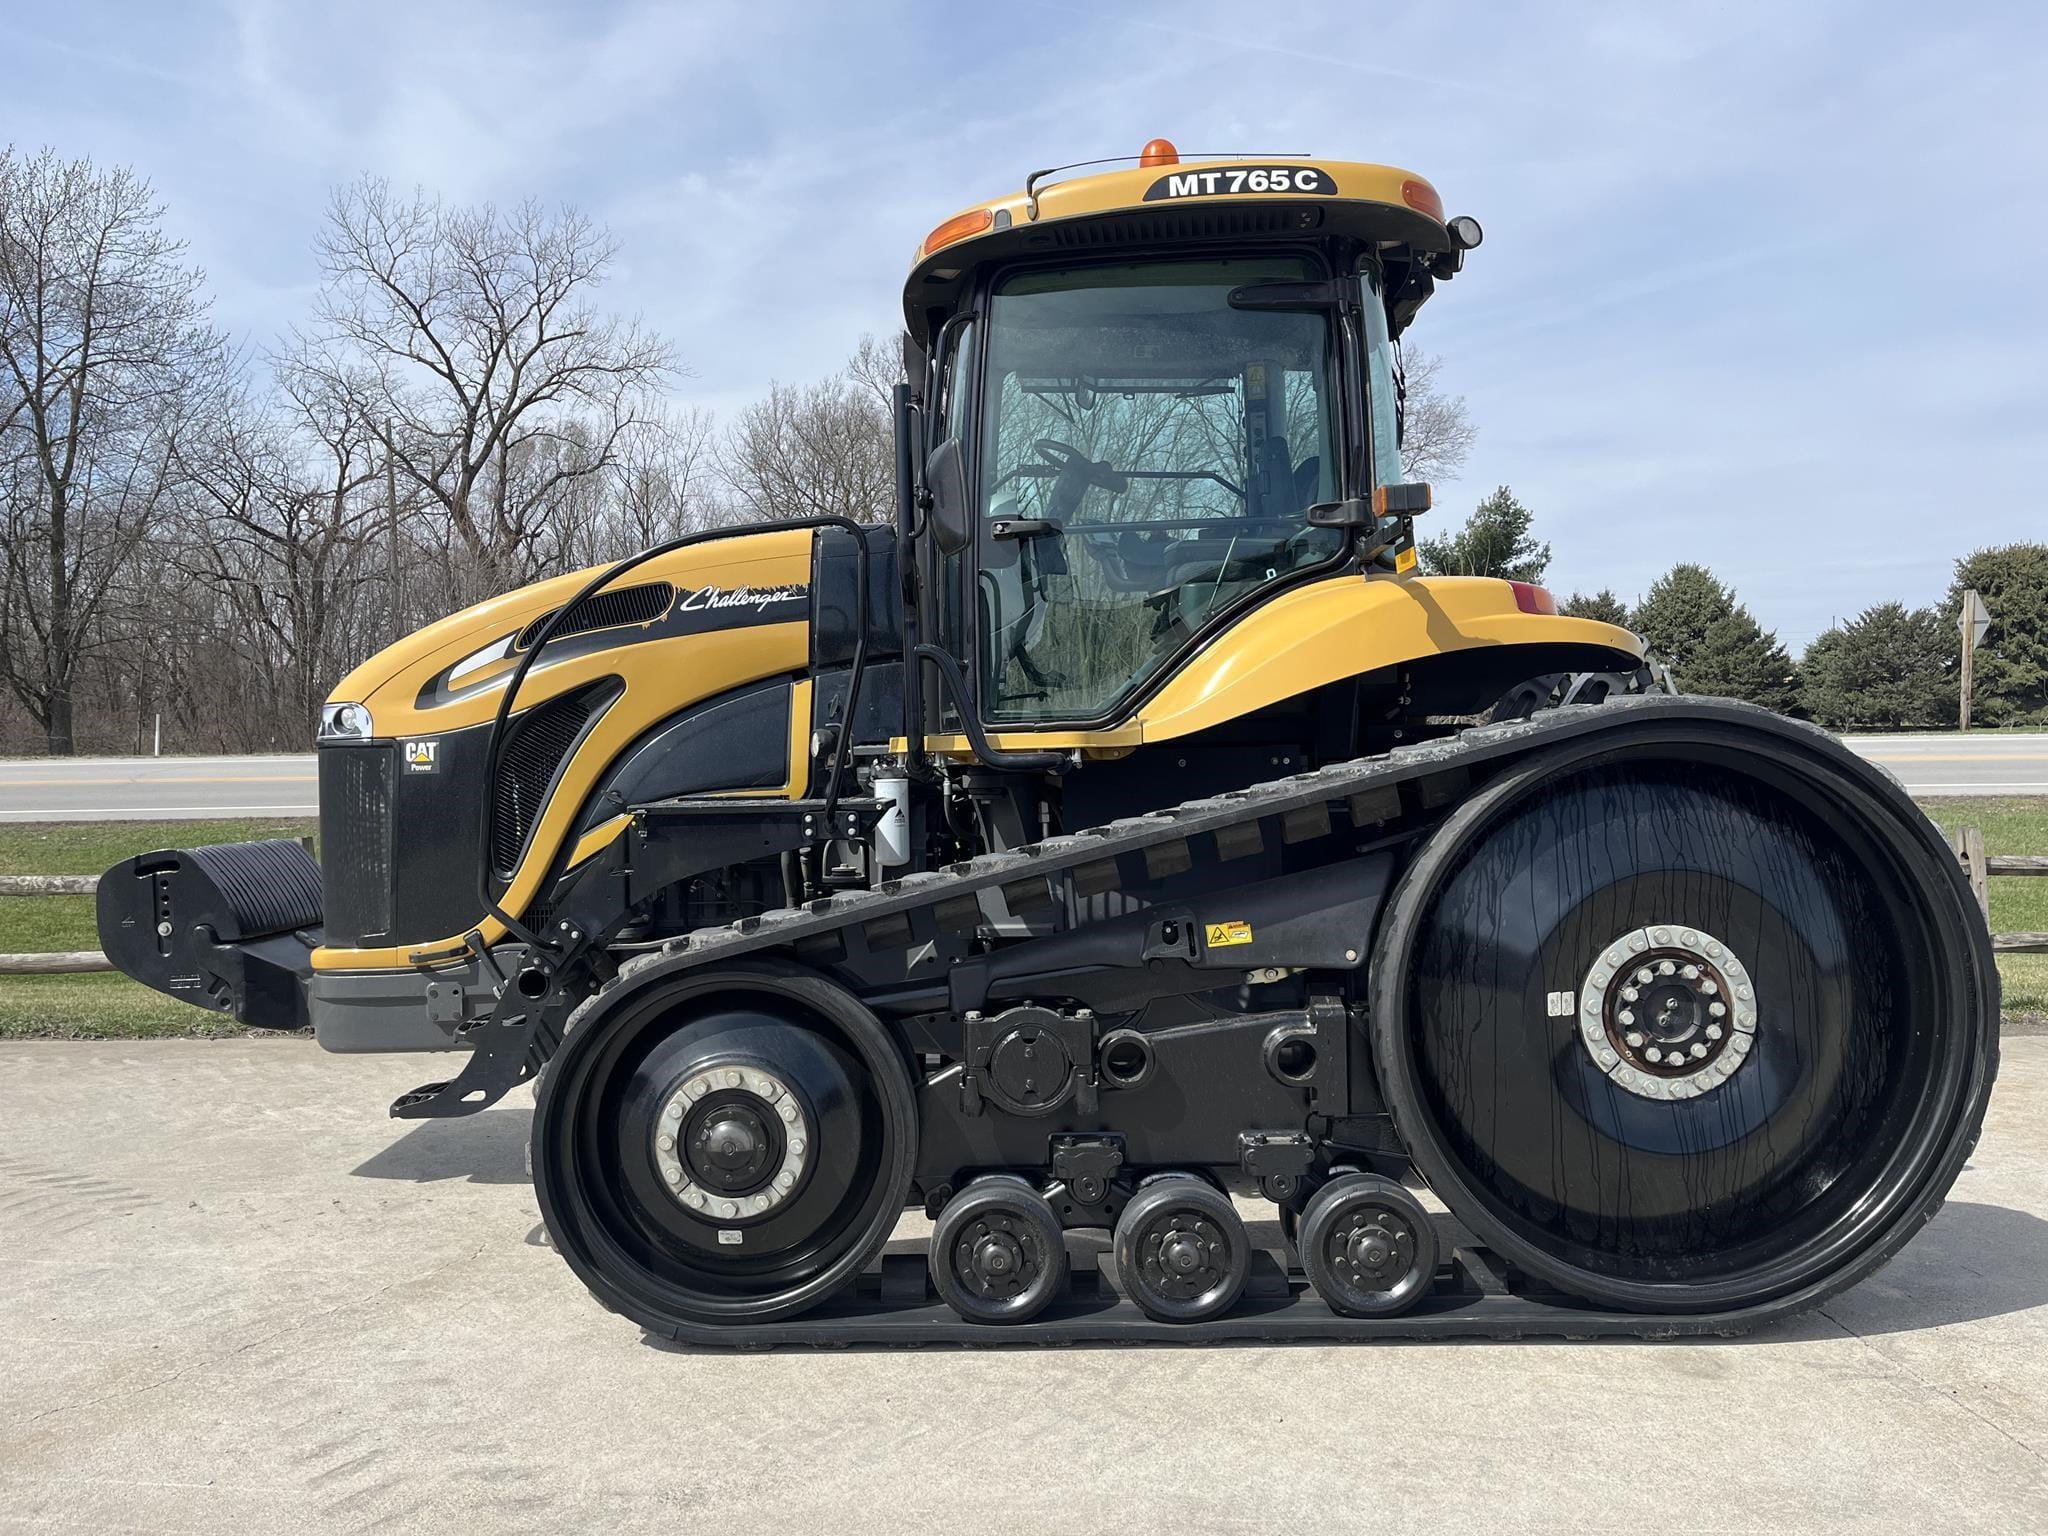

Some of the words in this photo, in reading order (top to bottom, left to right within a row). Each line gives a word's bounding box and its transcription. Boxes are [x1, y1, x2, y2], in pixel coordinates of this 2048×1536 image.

[680, 585, 808, 613] Challenger
[405, 741, 437, 763] CAT
[410, 763, 433, 772] Power
